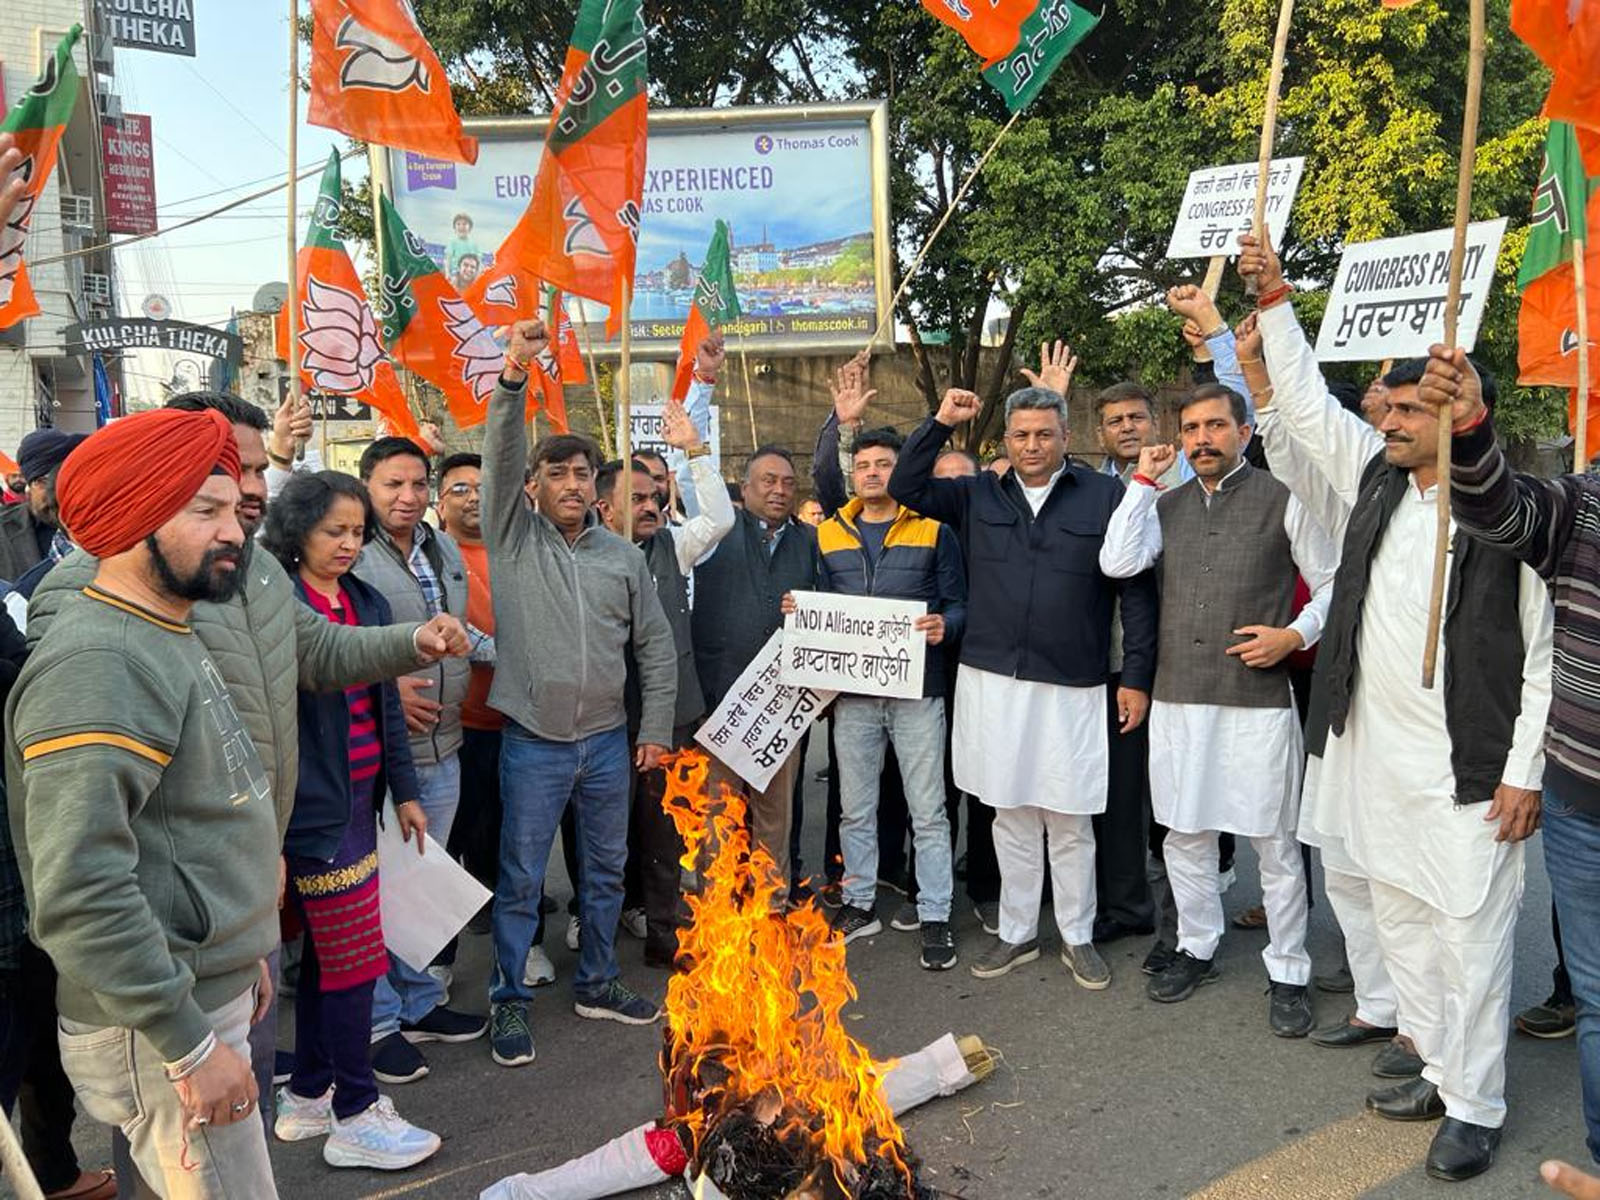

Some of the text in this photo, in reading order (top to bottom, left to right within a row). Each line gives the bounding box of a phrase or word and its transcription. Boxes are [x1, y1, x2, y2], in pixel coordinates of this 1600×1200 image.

[105, 14, 186, 48] THEKA
[108, 138, 150, 158] KINGS
[776, 135, 859, 150] Thomas Cook
[495, 166, 773, 198] EUR XPERIENCED
[667, 197, 704, 213] COOK
[1188, 200, 1245, 220] CONGRESS
[1344, 243, 1487, 294] CONGRESS PATY
[792, 318, 867, 332] thomascook.in
[82, 325, 229, 359] KULCHA THEKA
[795, 608, 822, 631] INDI
[824, 609, 874, 637] Alliance
